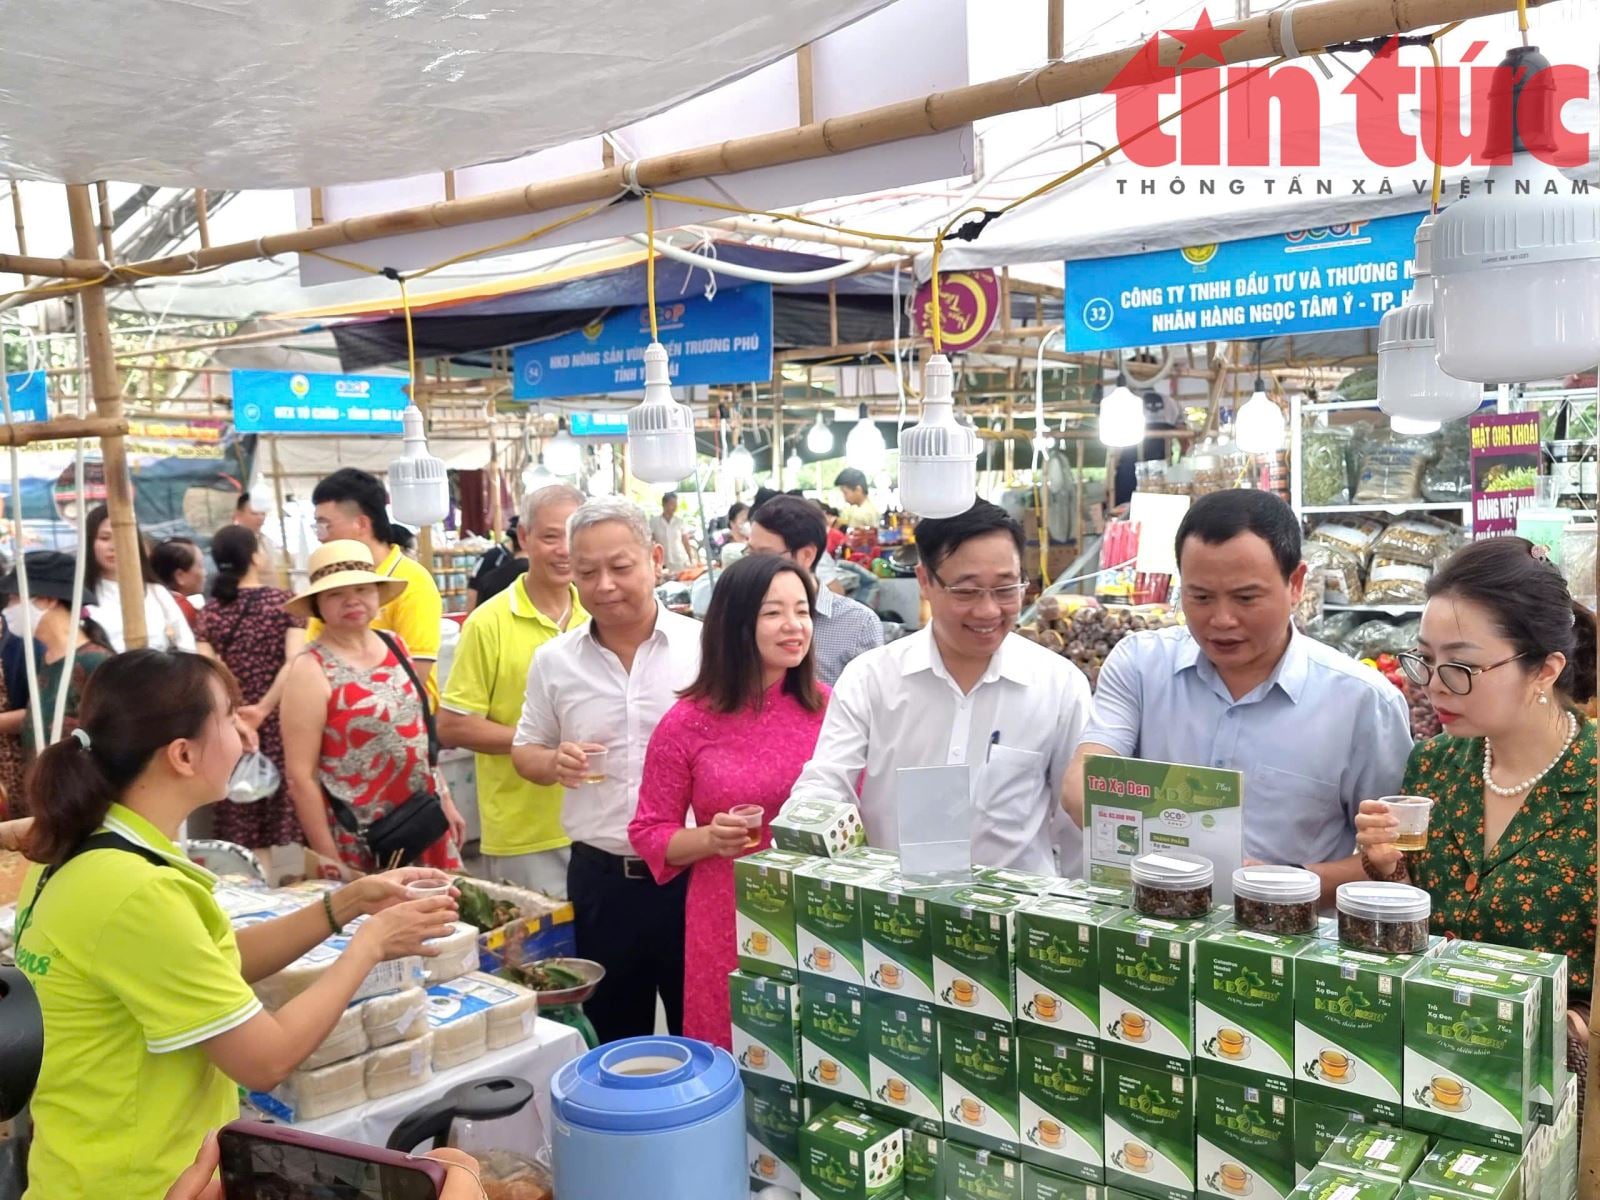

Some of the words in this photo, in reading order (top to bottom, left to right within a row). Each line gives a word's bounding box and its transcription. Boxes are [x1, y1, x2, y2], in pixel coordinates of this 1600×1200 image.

[1120, 286, 1163, 309] CÔNG
[1166, 285, 1185, 304] TY
[1189, 280, 1231, 302] TNHH
[1235, 271, 1269, 297] ĐẦU
[1273, 270, 1296, 293] TƯ
[1299, 267, 1322, 290] VÀ
[1326, 261, 1398, 287] THƯƠNG
[1089, 307, 1107, 322] 32
[1152, 309, 1197, 333] NHÃN
[1200, 305, 1245, 328] HÀNG
[1249, 300, 1296, 325] NGỌC
[1300, 295, 1338, 319] TÂM
[1343, 291, 1354, 315] Ý
[1371, 291, 1395, 312] TP.
[572, 351, 601, 367] NÔNG
[684, 337, 731, 355] TRƯƠNG
[1471, 422, 1490, 453] MẬT
[1492, 425, 1511, 447] ONG
[1511, 419, 1538, 446] KHOÁI
[1477, 494, 1500, 521] HÀNG
[1500, 493, 1517, 523] VIỆT
[1088, 776, 1107, 791] Trà
[1108, 777, 1125, 797] Xạ
[1126, 781, 1151, 797] Đen
